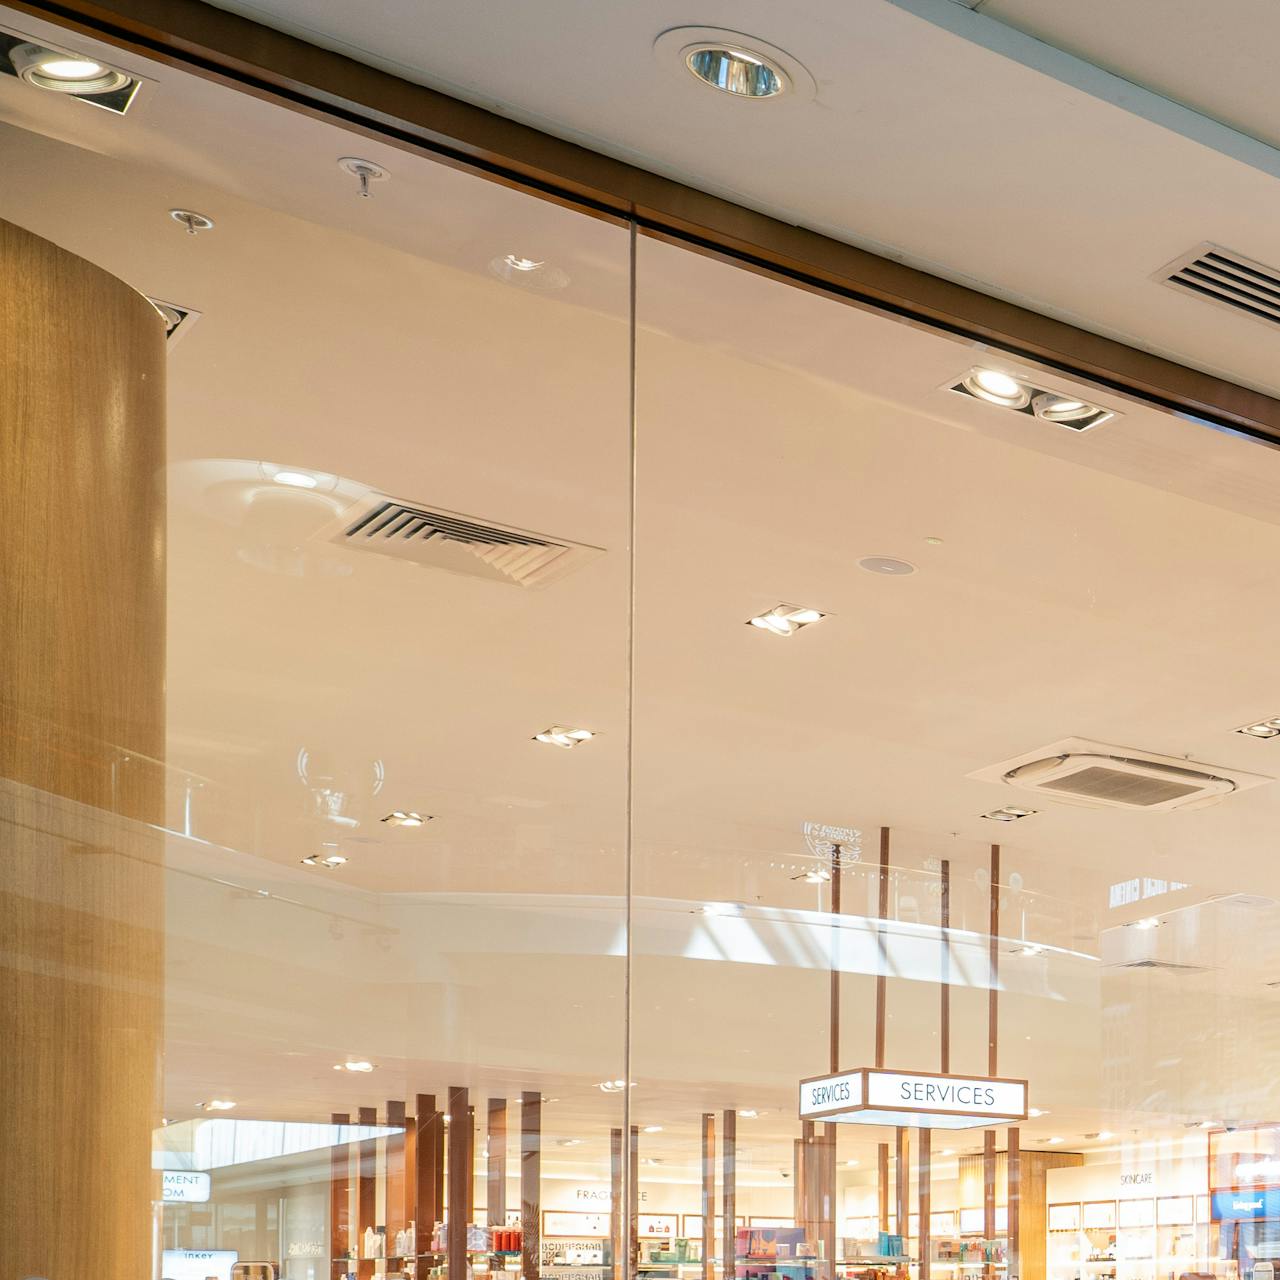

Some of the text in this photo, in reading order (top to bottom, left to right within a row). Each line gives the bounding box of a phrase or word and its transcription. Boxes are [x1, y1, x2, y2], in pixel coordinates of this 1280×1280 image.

[812, 1081, 850, 1107] SERVICES
[900, 1081, 995, 1106] SERVICES
[164, 1176, 200, 1185] MENT
[1120, 1173, 1152, 1186] SKINCARE
[162, 1188, 184, 1197] OM
[577, 1189, 648, 1201] FRAGCE
